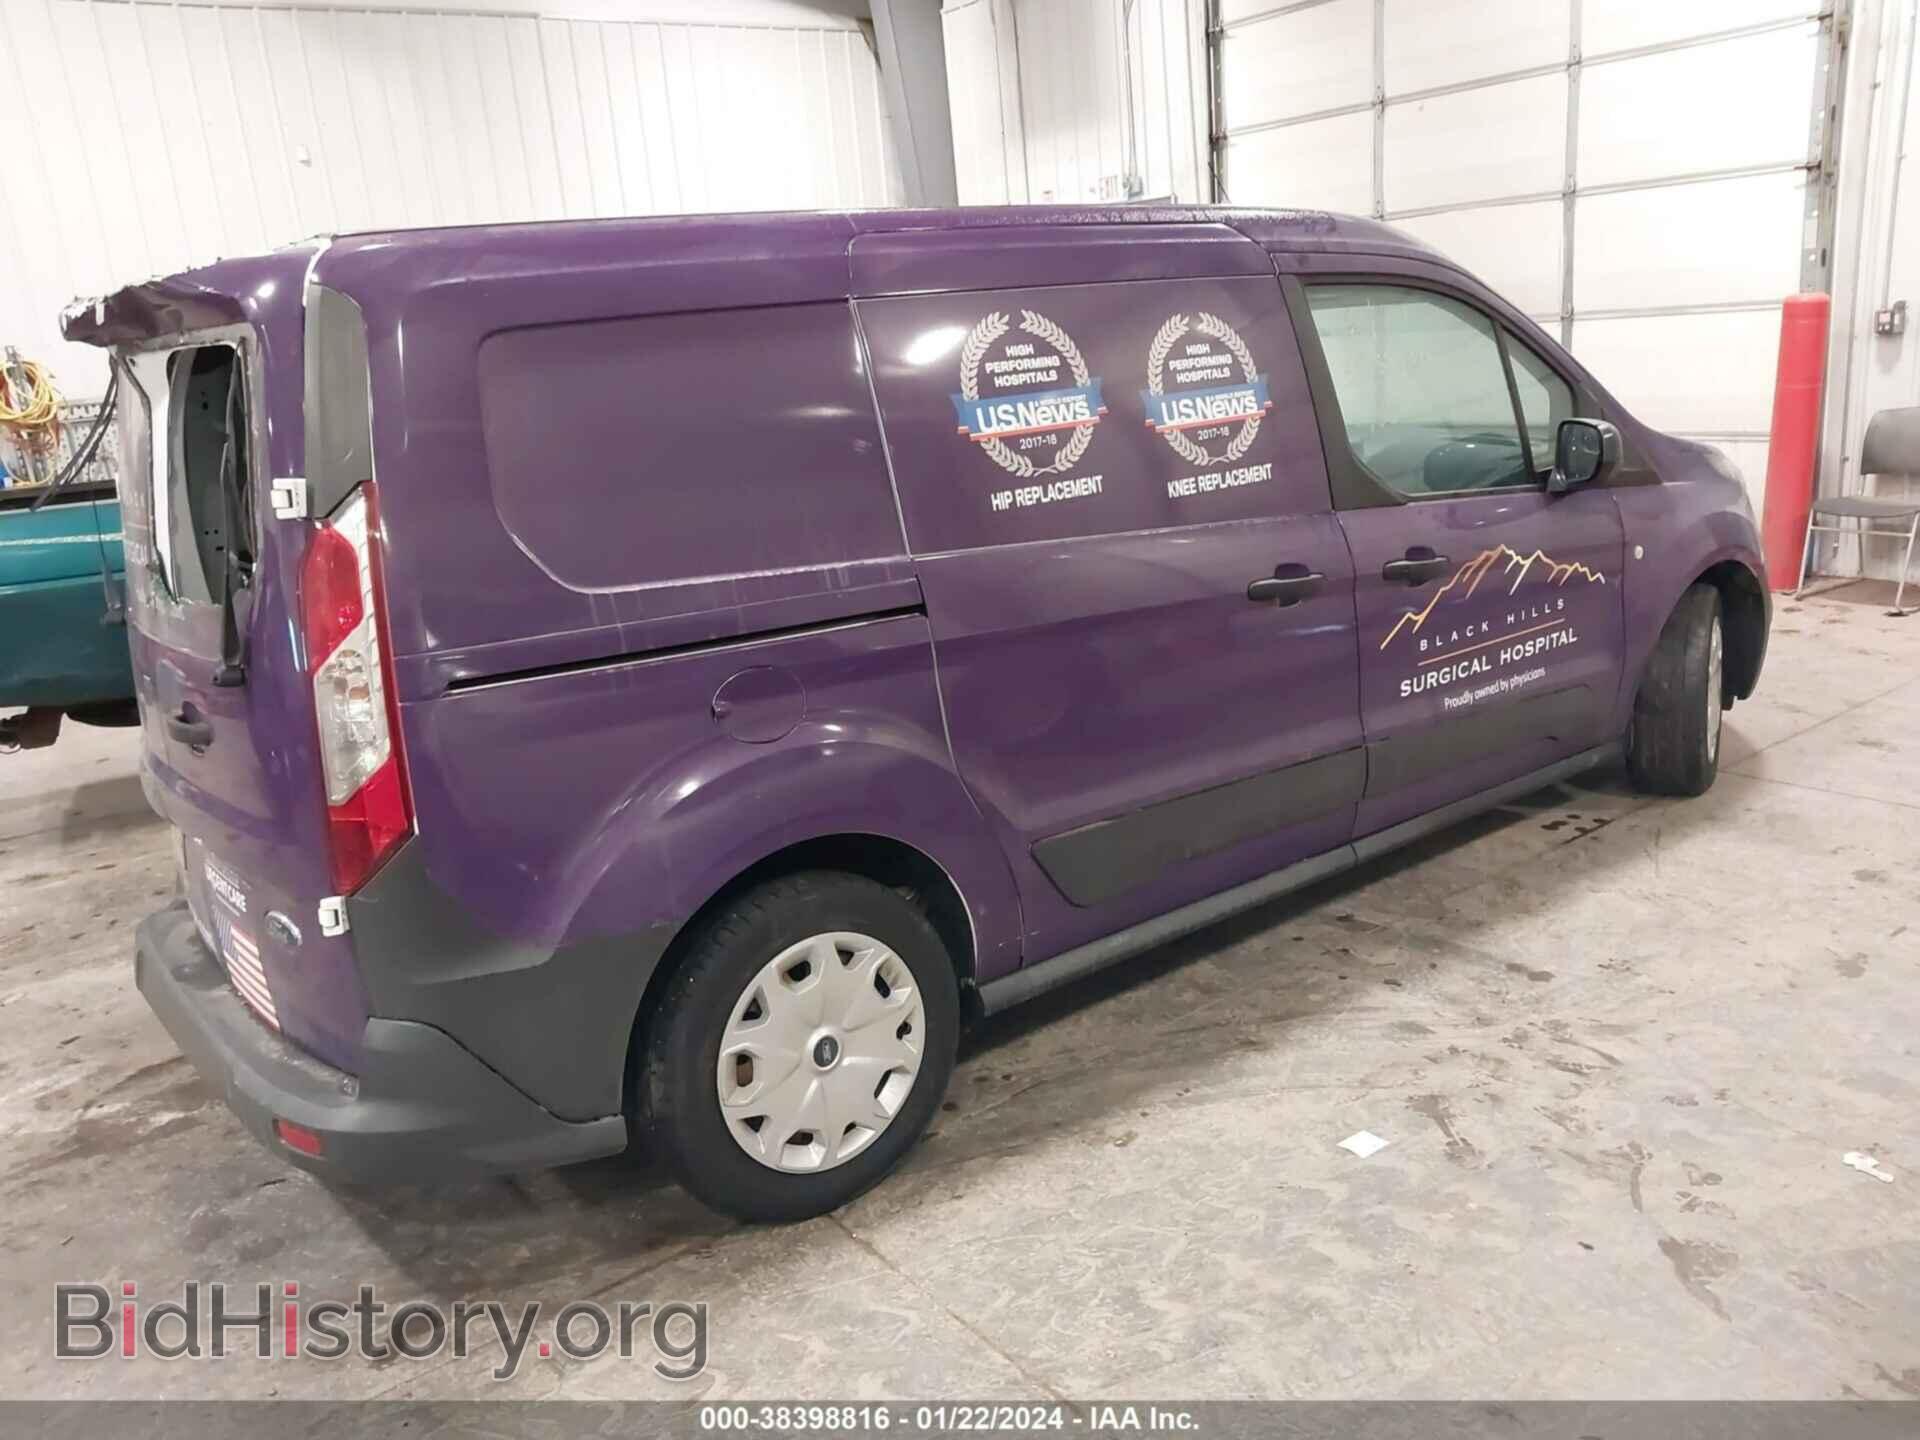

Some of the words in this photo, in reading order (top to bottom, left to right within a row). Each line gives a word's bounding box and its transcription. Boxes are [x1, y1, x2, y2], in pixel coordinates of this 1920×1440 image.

[1005, 343, 1034, 357] HIGH
[1186, 343, 1210, 355] HIGH
[985, 355, 1060, 374] PERFORMING
[1168, 354, 1232, 371] PERFORMING
[994, 369, 1058, 388] HOSPITALS
[1176, 367, 1231, 383] HOSPITALS
[1019, 434, 1057, 450] 2017-18
[1167, 478, 1197, 498] KNEE
[1198, 463, 1272, 493] REPLACEMENT
[991, 490, 1013, 511] HIP
[1016, 475, 1103, 508] REPLACEMENT
[1419, 620, 1489, 651] BLACK
[1507, 598, 1565, 625] HILLS
[1400, 655, 1492, 698] SURGICAL
[1500, 627, 1577, 665] HOSPITAL
[1444, 691, 1474, 711] Proudly
[1474, 682, 1500, 701] owned
[1500, 677, 1511, 692] by
[1510, 666, 1546, 691] physicians
